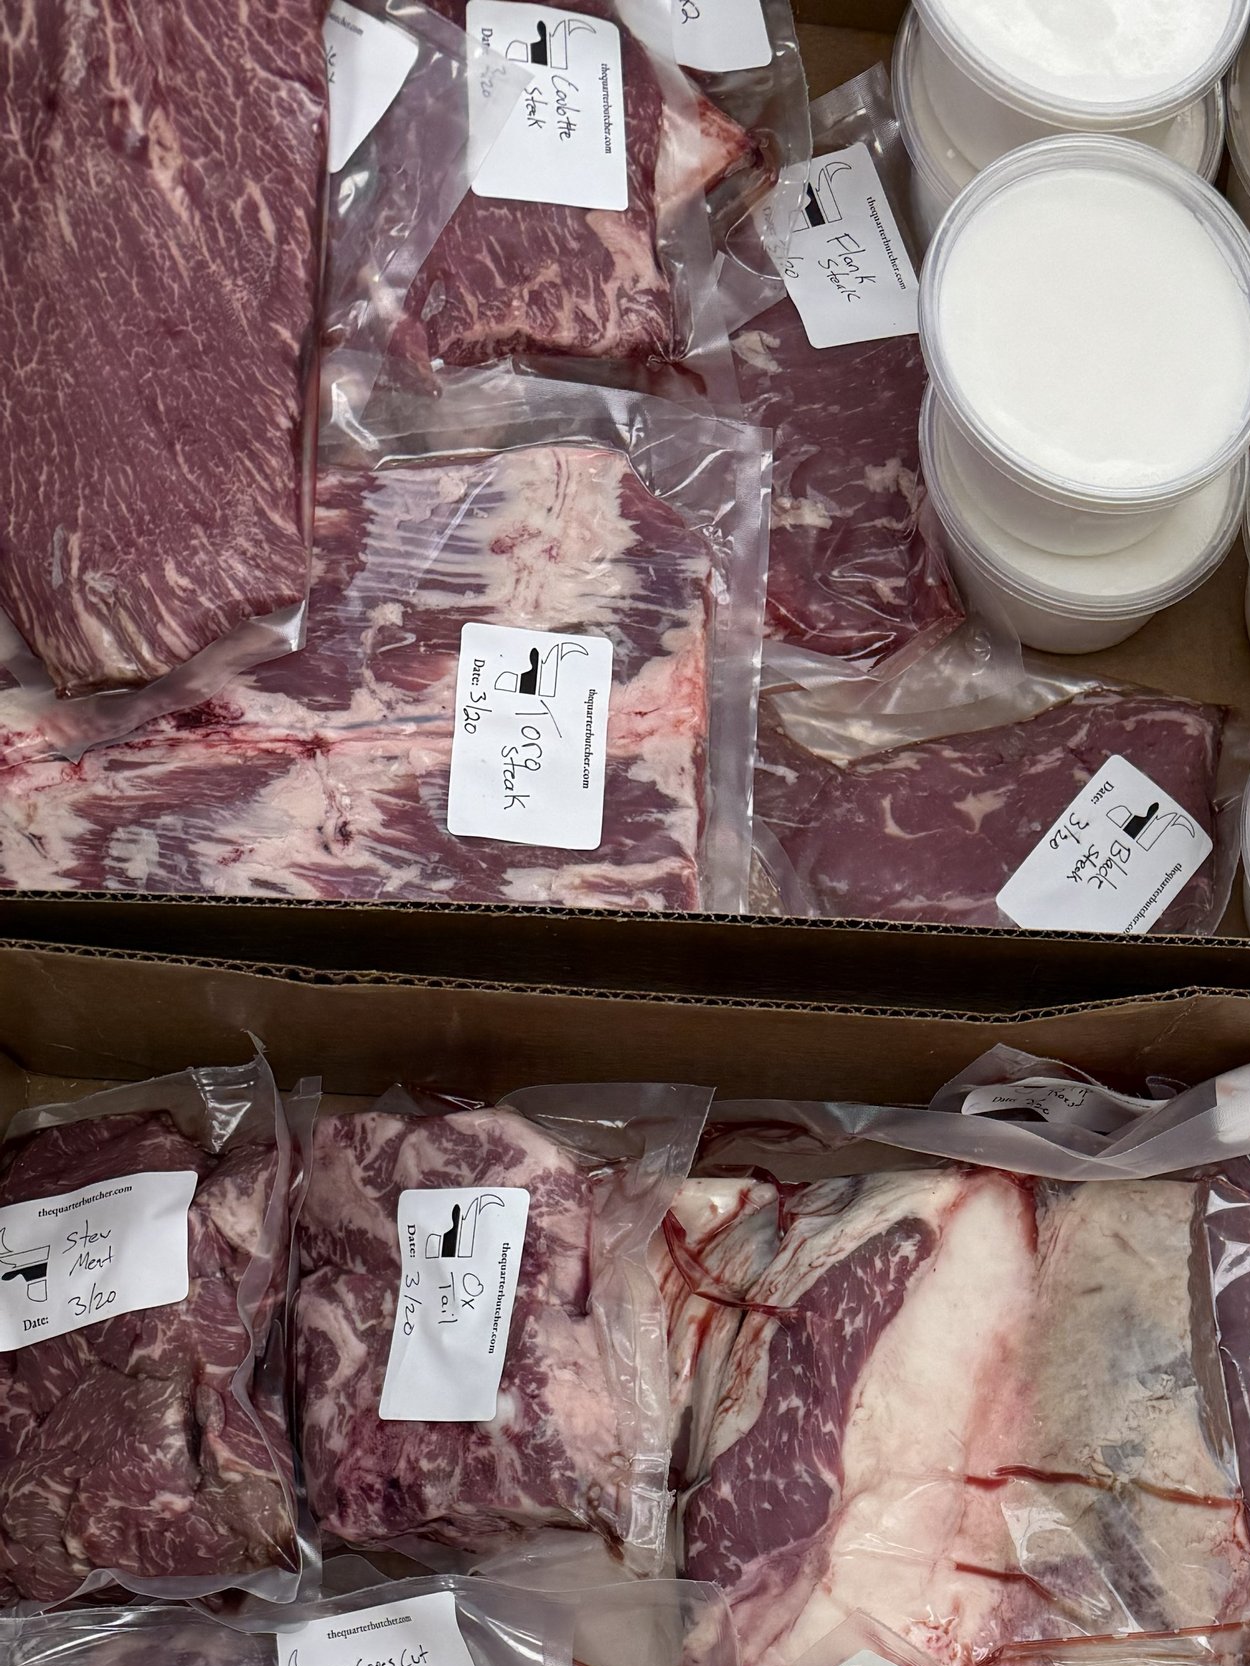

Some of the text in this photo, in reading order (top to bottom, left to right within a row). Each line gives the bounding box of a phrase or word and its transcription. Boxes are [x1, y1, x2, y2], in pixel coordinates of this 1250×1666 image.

[482, 28, 493, 55] Dat
[601, 63, 612, 154] thequarterbutcher.com
[826, 232, 876, 284] Flank
[866, 196, 906, 290] thequarterbutcher.com
[463, 659, 493, 734] Date: 3/20
[583, 689, 597, 789] thequarterbutcher.com
[1049, 780, 1115, 849] Date: 3/20
[1087, 840, 1131, 890] Blade
[38, 1184, 133, 1218] thequarterbutcher.com
[69, 1245, 115, 1277] Meat
[403, 1224, 422, 1335] Date: 3/20
[23, 1282, 117, 1331] Date: 3/20
[438, 1271, 458, 1324] Tail
[461, 1272, 484, 1310] Ox
[488, 1242, 511, 1354] thequarterbutcher.com
[327, 1615, 412, 1640] thequarterbutcher.com
